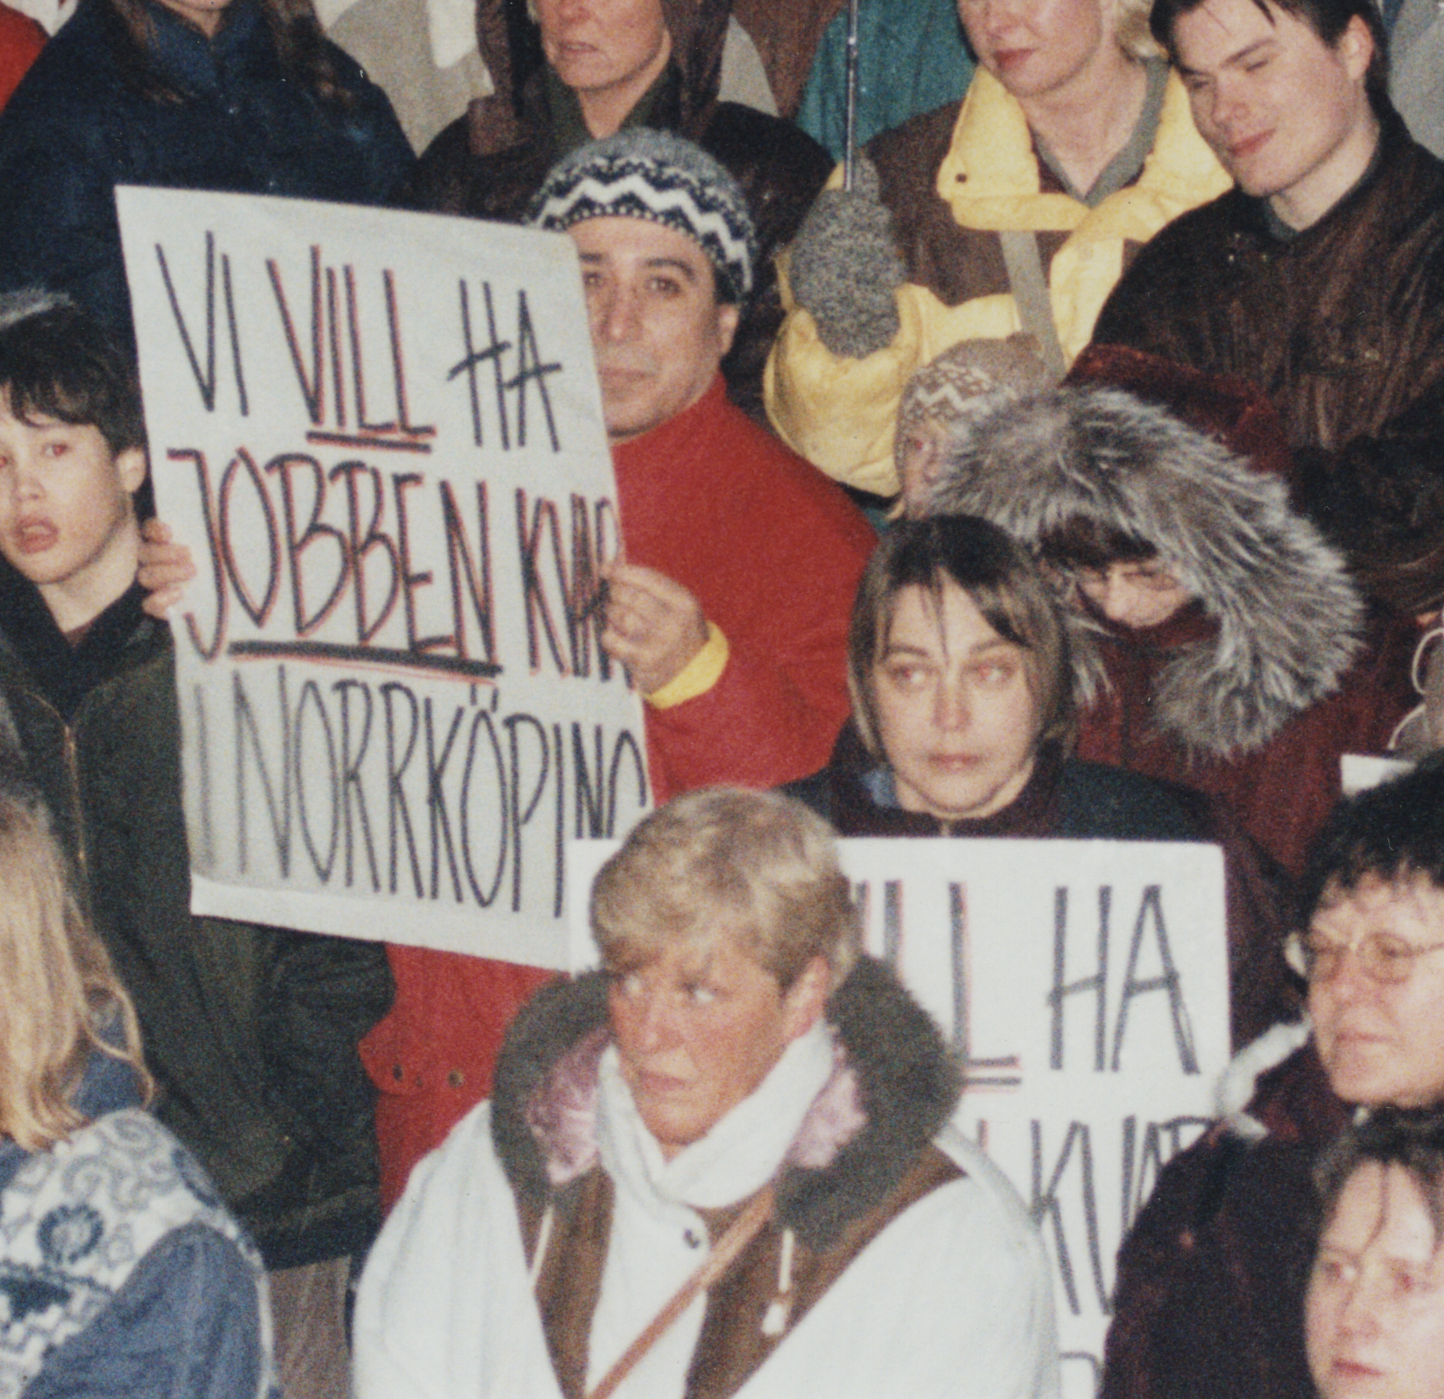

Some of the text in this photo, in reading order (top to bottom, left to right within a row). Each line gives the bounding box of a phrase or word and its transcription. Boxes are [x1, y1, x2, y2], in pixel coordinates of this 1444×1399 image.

[155, 230, 563, 453] VI VILL HA
[166, 446, 498, 666] JOBBEN
[1045, 883, 1199, 1076] HA
